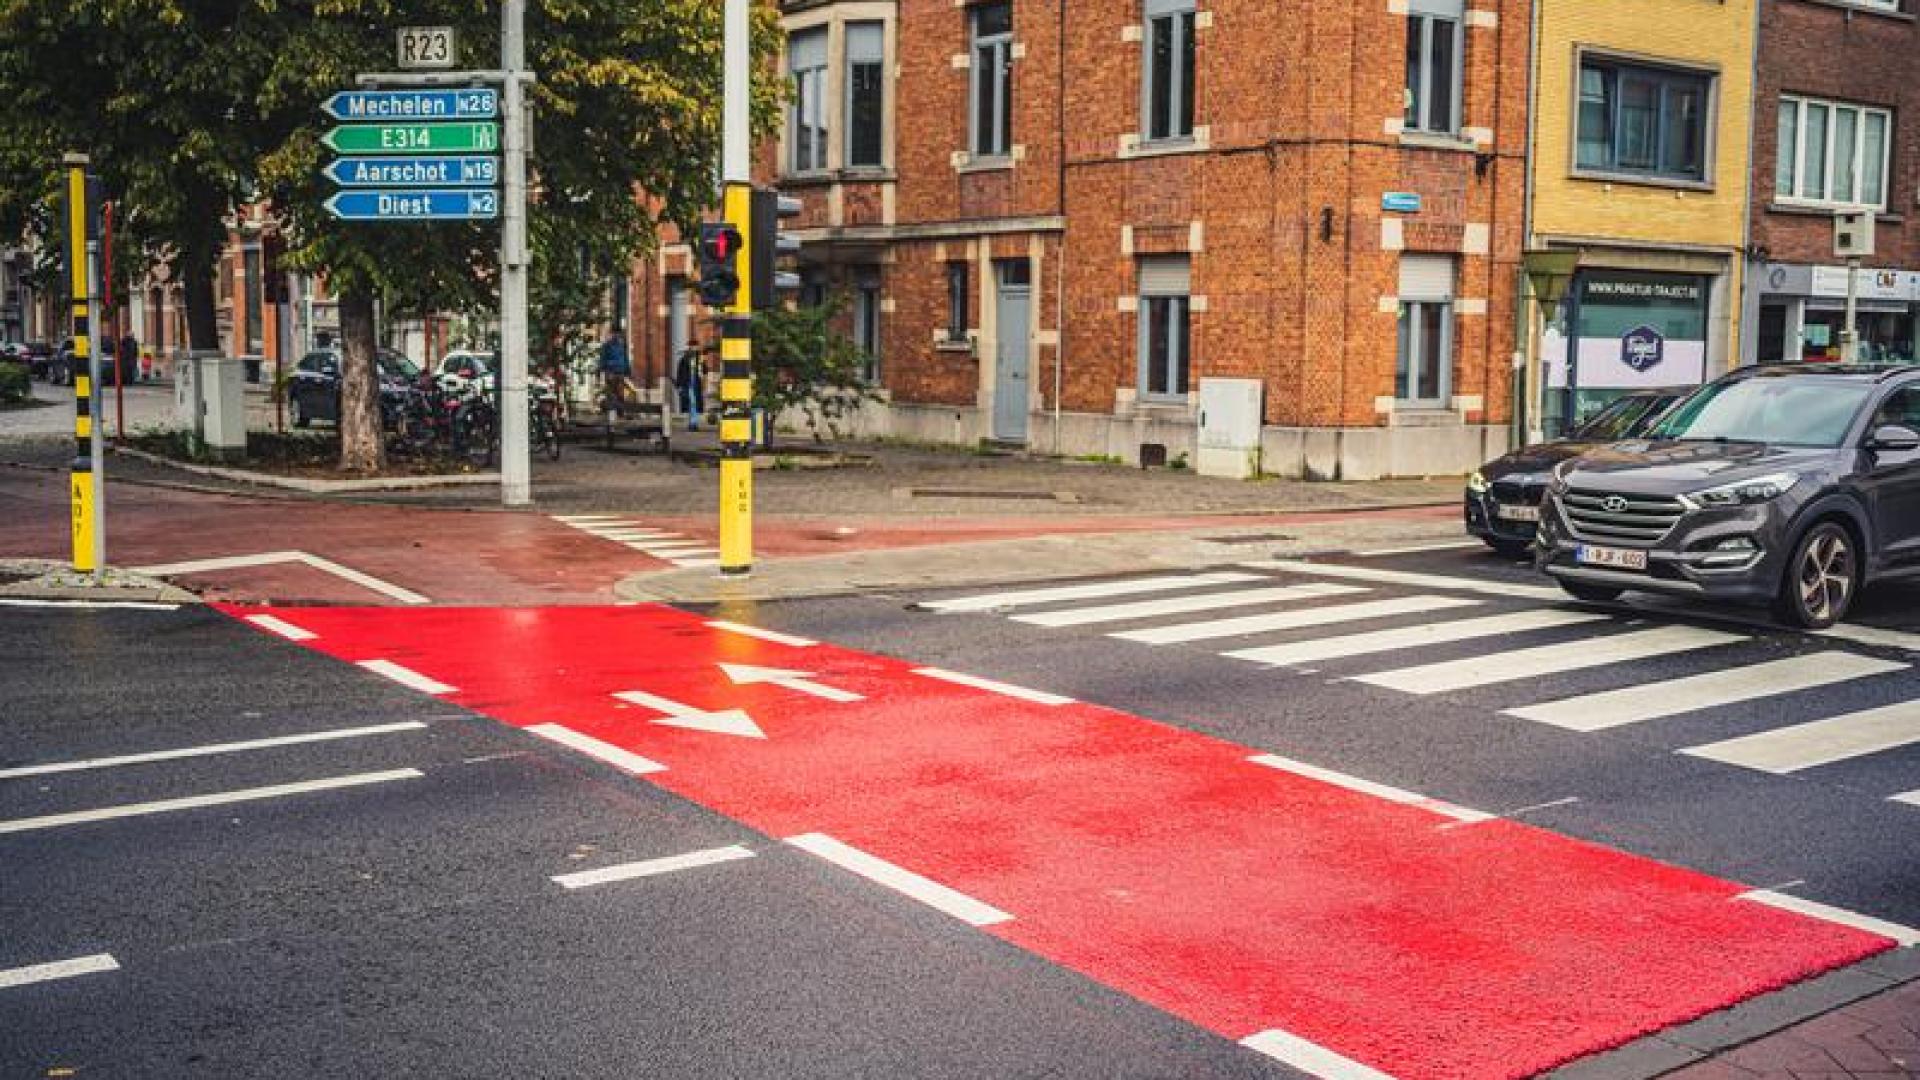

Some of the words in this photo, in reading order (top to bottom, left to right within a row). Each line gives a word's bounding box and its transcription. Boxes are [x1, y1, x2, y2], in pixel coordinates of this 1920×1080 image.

[404, 33, 447, 61] R23
[350, 95, 445, 116] Mechelen
[459, 95, 493, 112] N26
[381, 128, 430, 147] E314
[355, 161, 447, 181] Aarschot
[464, 161, 493, 179] N19
[378, 195, 431, 214] Diest
[471, 195, 493, 212] N2
